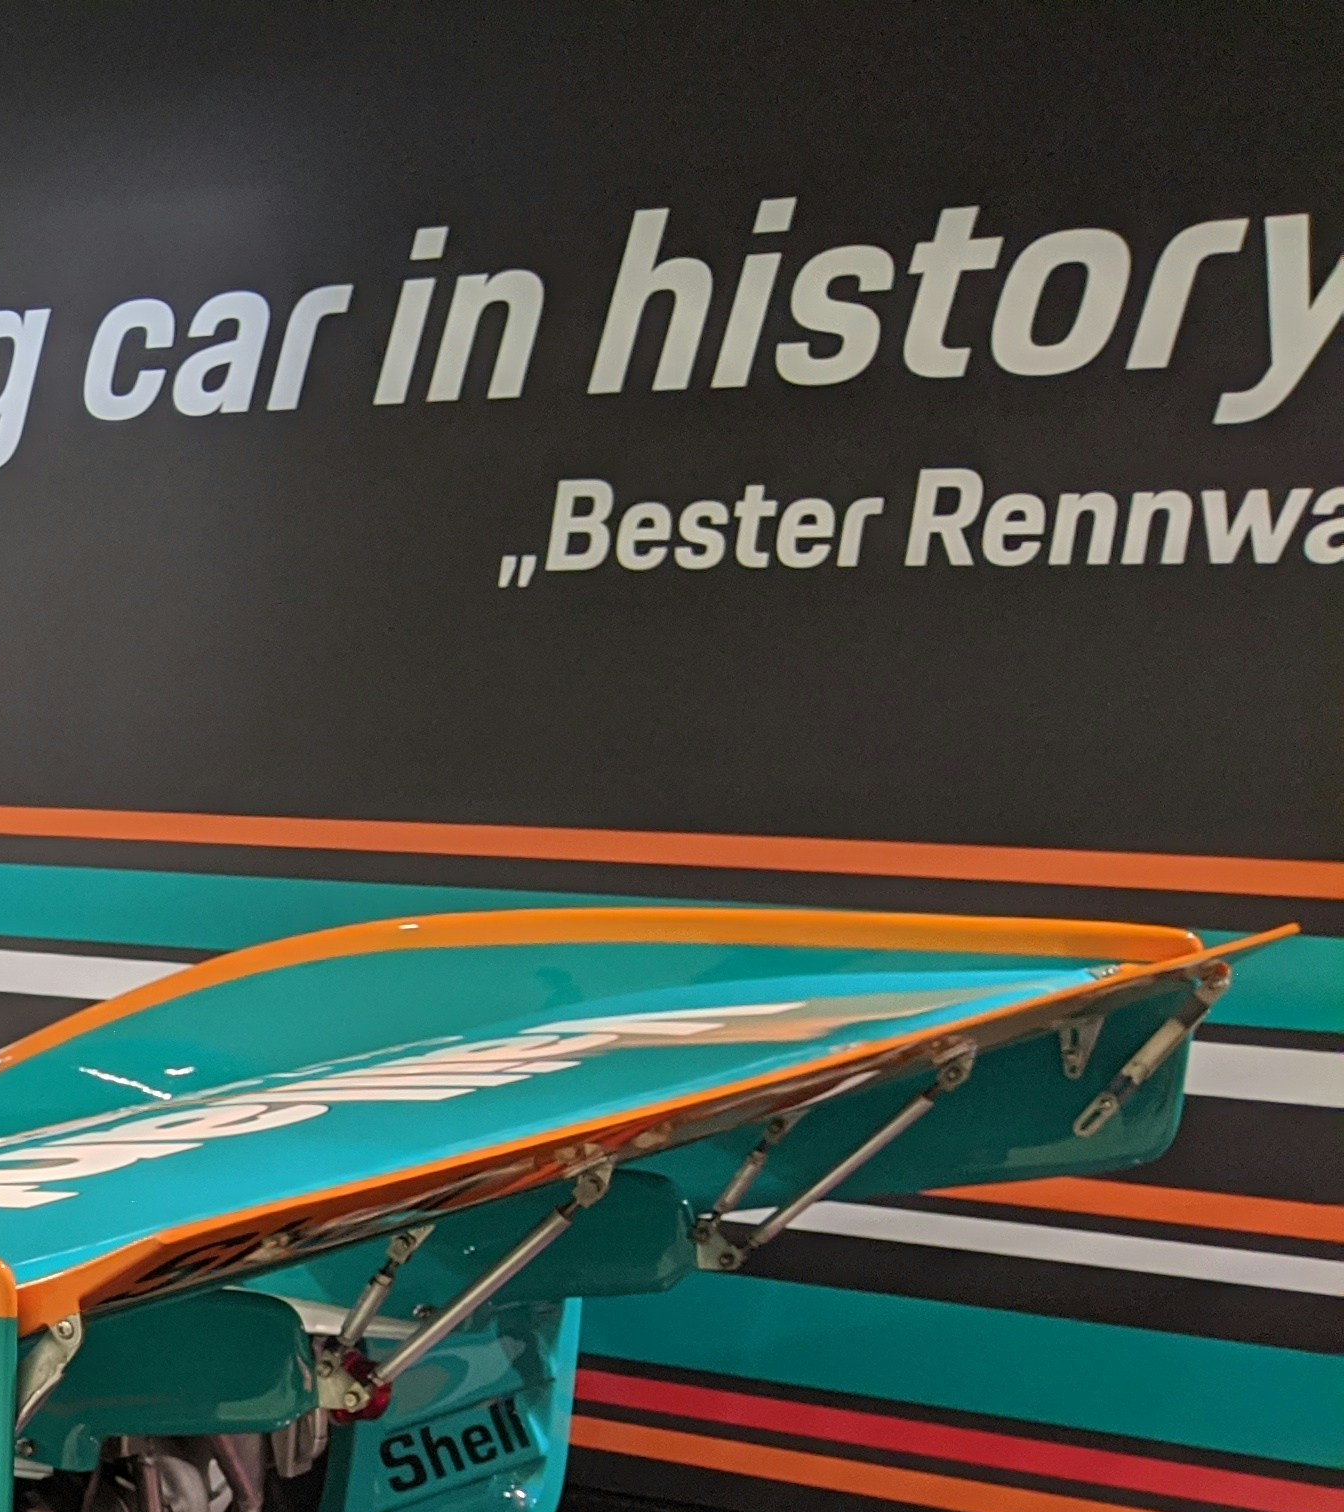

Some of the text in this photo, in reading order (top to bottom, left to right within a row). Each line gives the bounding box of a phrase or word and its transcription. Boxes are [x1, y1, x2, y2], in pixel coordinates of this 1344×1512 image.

[84, 284, 353, 421] car
[373, 226, 545, 406] in
[587, 196, 1344, 425] history
[379, 1399, 531, 1493] Shell
